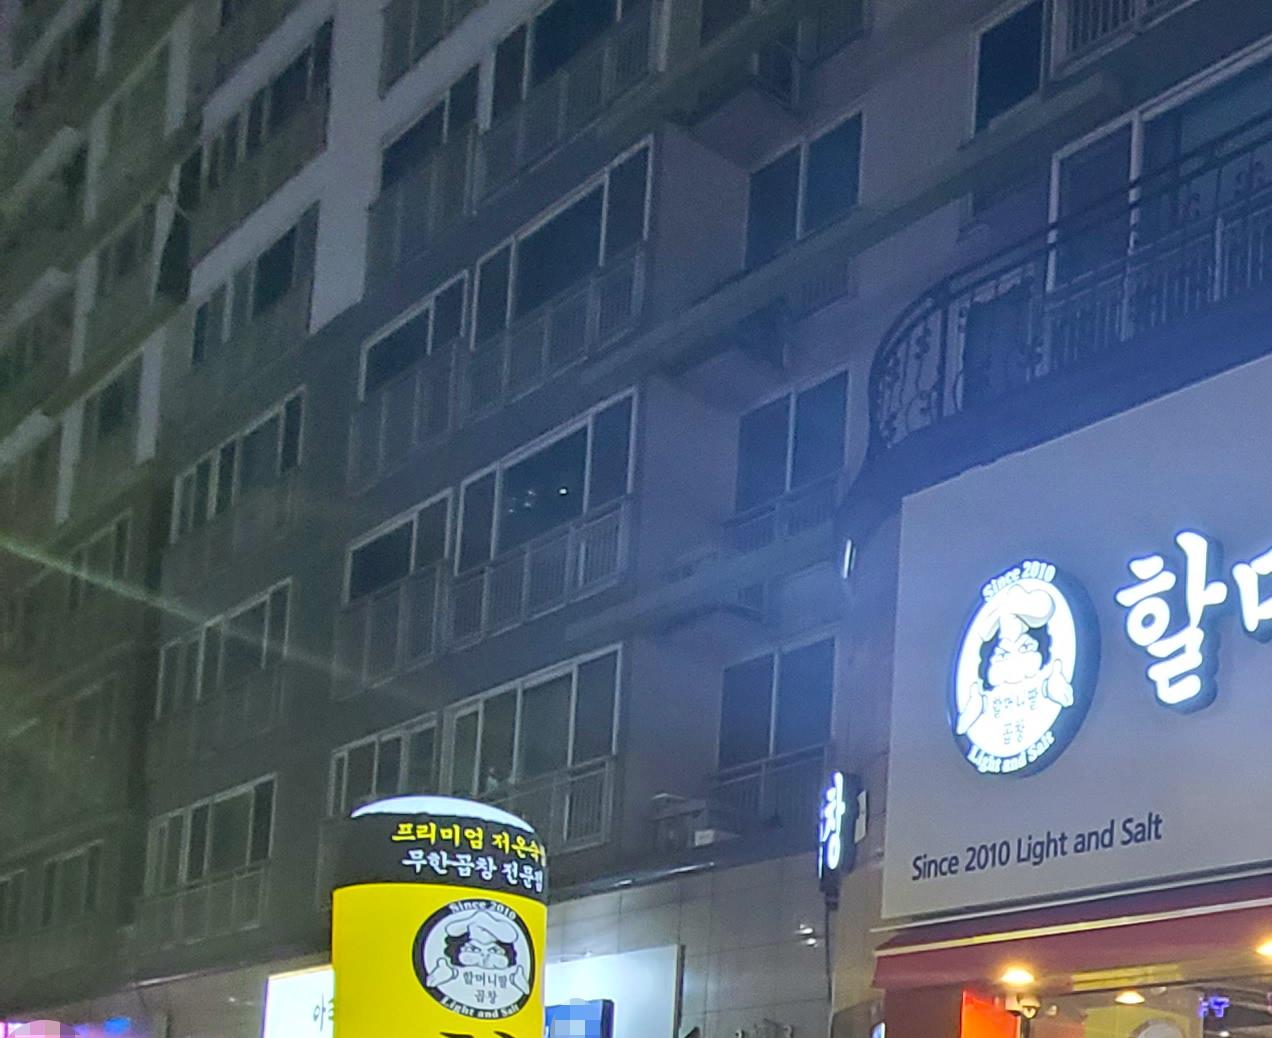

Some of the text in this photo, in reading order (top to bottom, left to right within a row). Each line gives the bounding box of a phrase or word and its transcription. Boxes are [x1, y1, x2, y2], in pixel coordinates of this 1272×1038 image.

[982, 560, 1057, 603] Since 2010
[966, 730, 1055, 773] Light and Salt
[391, 822, 484, 850] 프리미엄
[911, 811, 1163, 881] Since 2010 Light and Salt
[402, 849, 498, 881] 무한곱창
[449, 900, 517, 920] Since 2010
[441, 994, 475, 1016] Light
[477, 1008, 499, 1018] and
